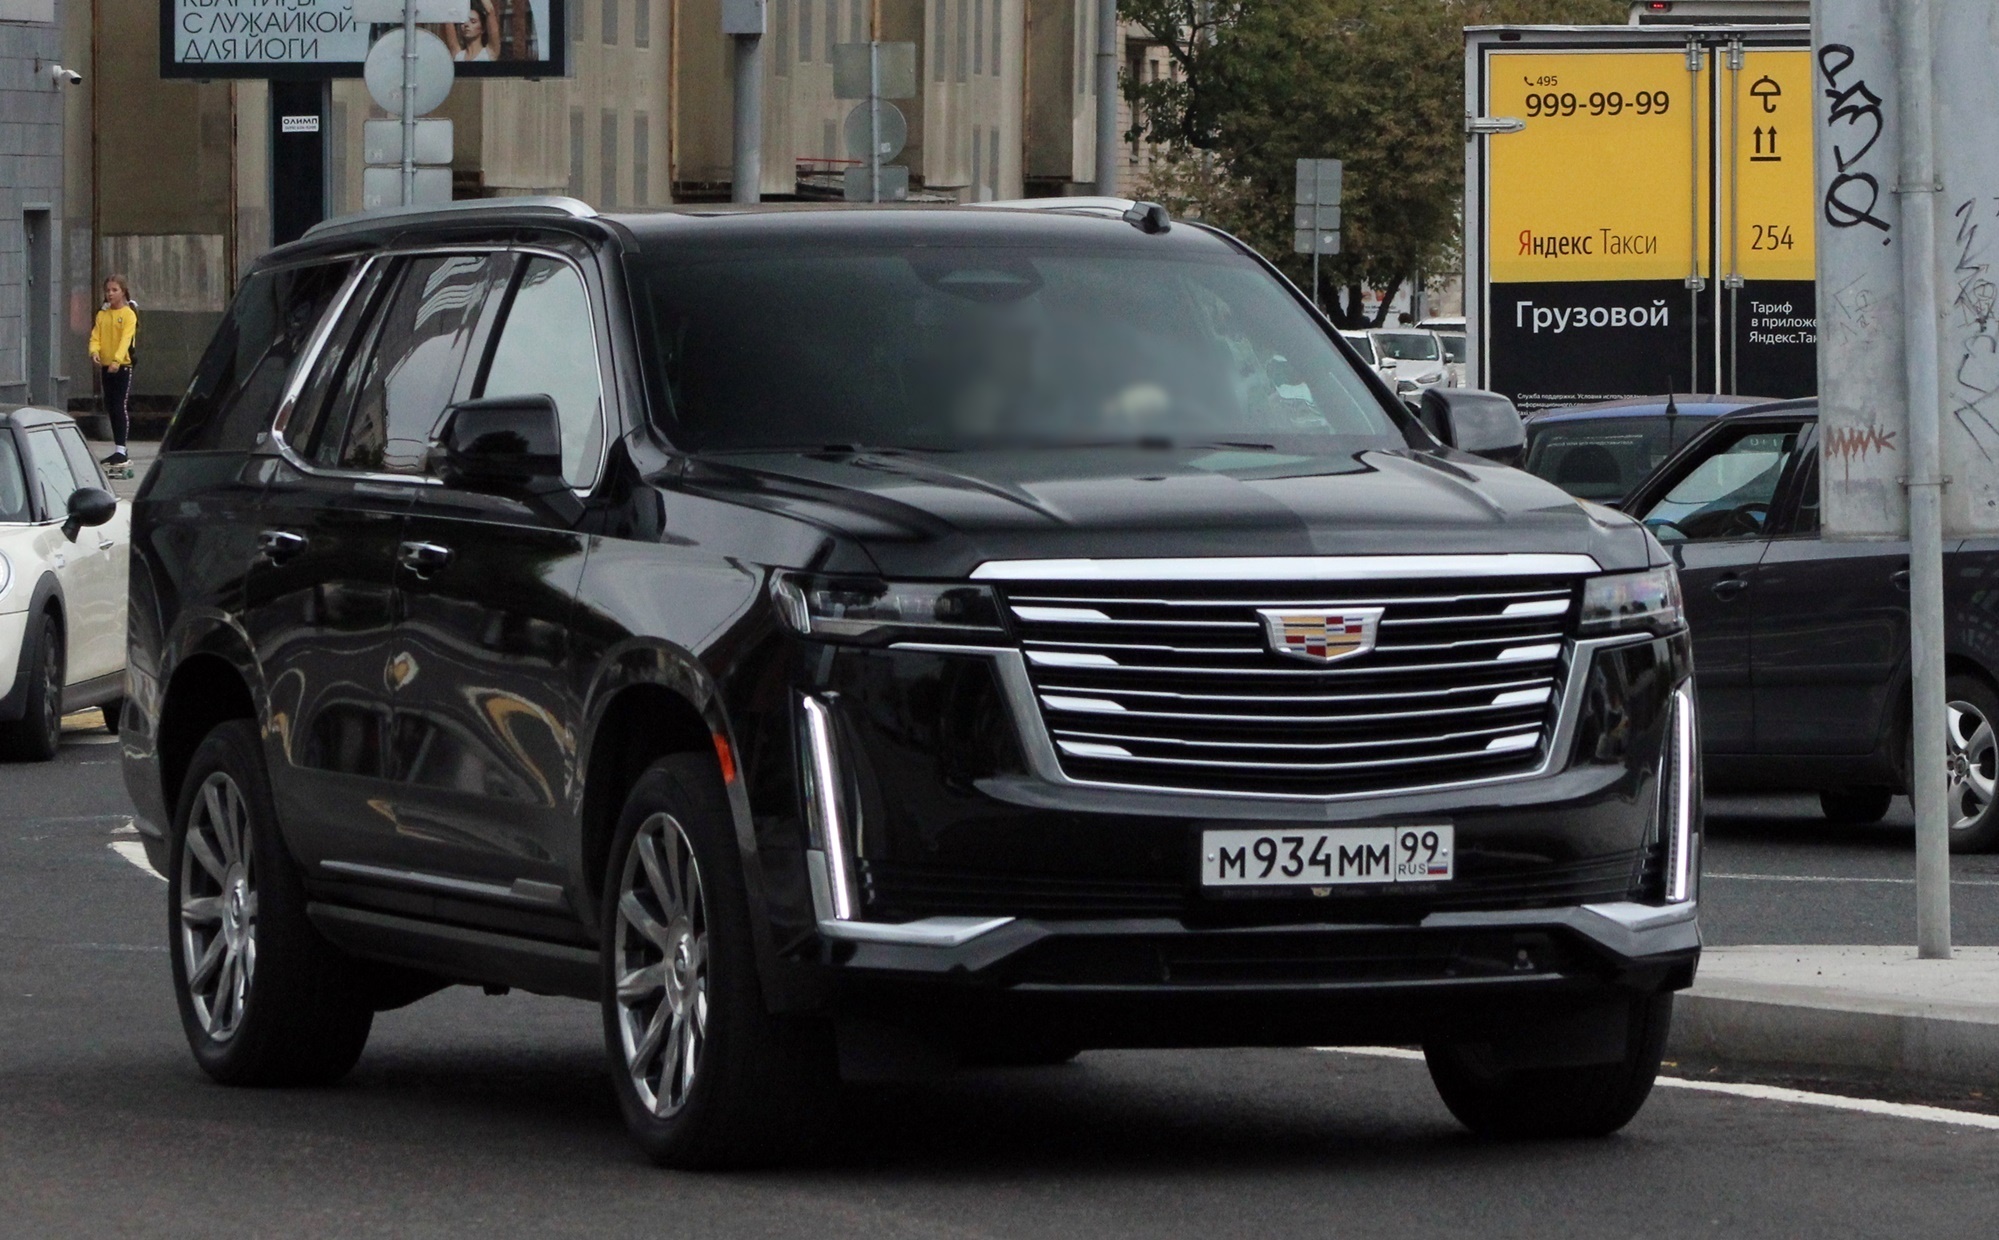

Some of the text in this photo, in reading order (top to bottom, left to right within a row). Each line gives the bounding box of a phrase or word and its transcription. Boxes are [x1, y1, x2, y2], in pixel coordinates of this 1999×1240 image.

[183, 6, 357, 33] С ЛУЖАЙКОЙ
[182, 33, 318, 63] ДЛЯ ЙОГИ
[1536, 75, 1558, 87] 495
[1525, 90, 1670, 117] 999-99-99
[1518, 228, 1658, 259] Яндекс Такси
[1751, 224, 1794, 250] 254
[1516, 299, 1669, 334] Грузовой
[1750, 301, 1793, 315] Тариф
[1751, 318, 1759, 327] в
[1400, 831, 1439, 863] 99
[1399, 862, 1427, 875] RUS
